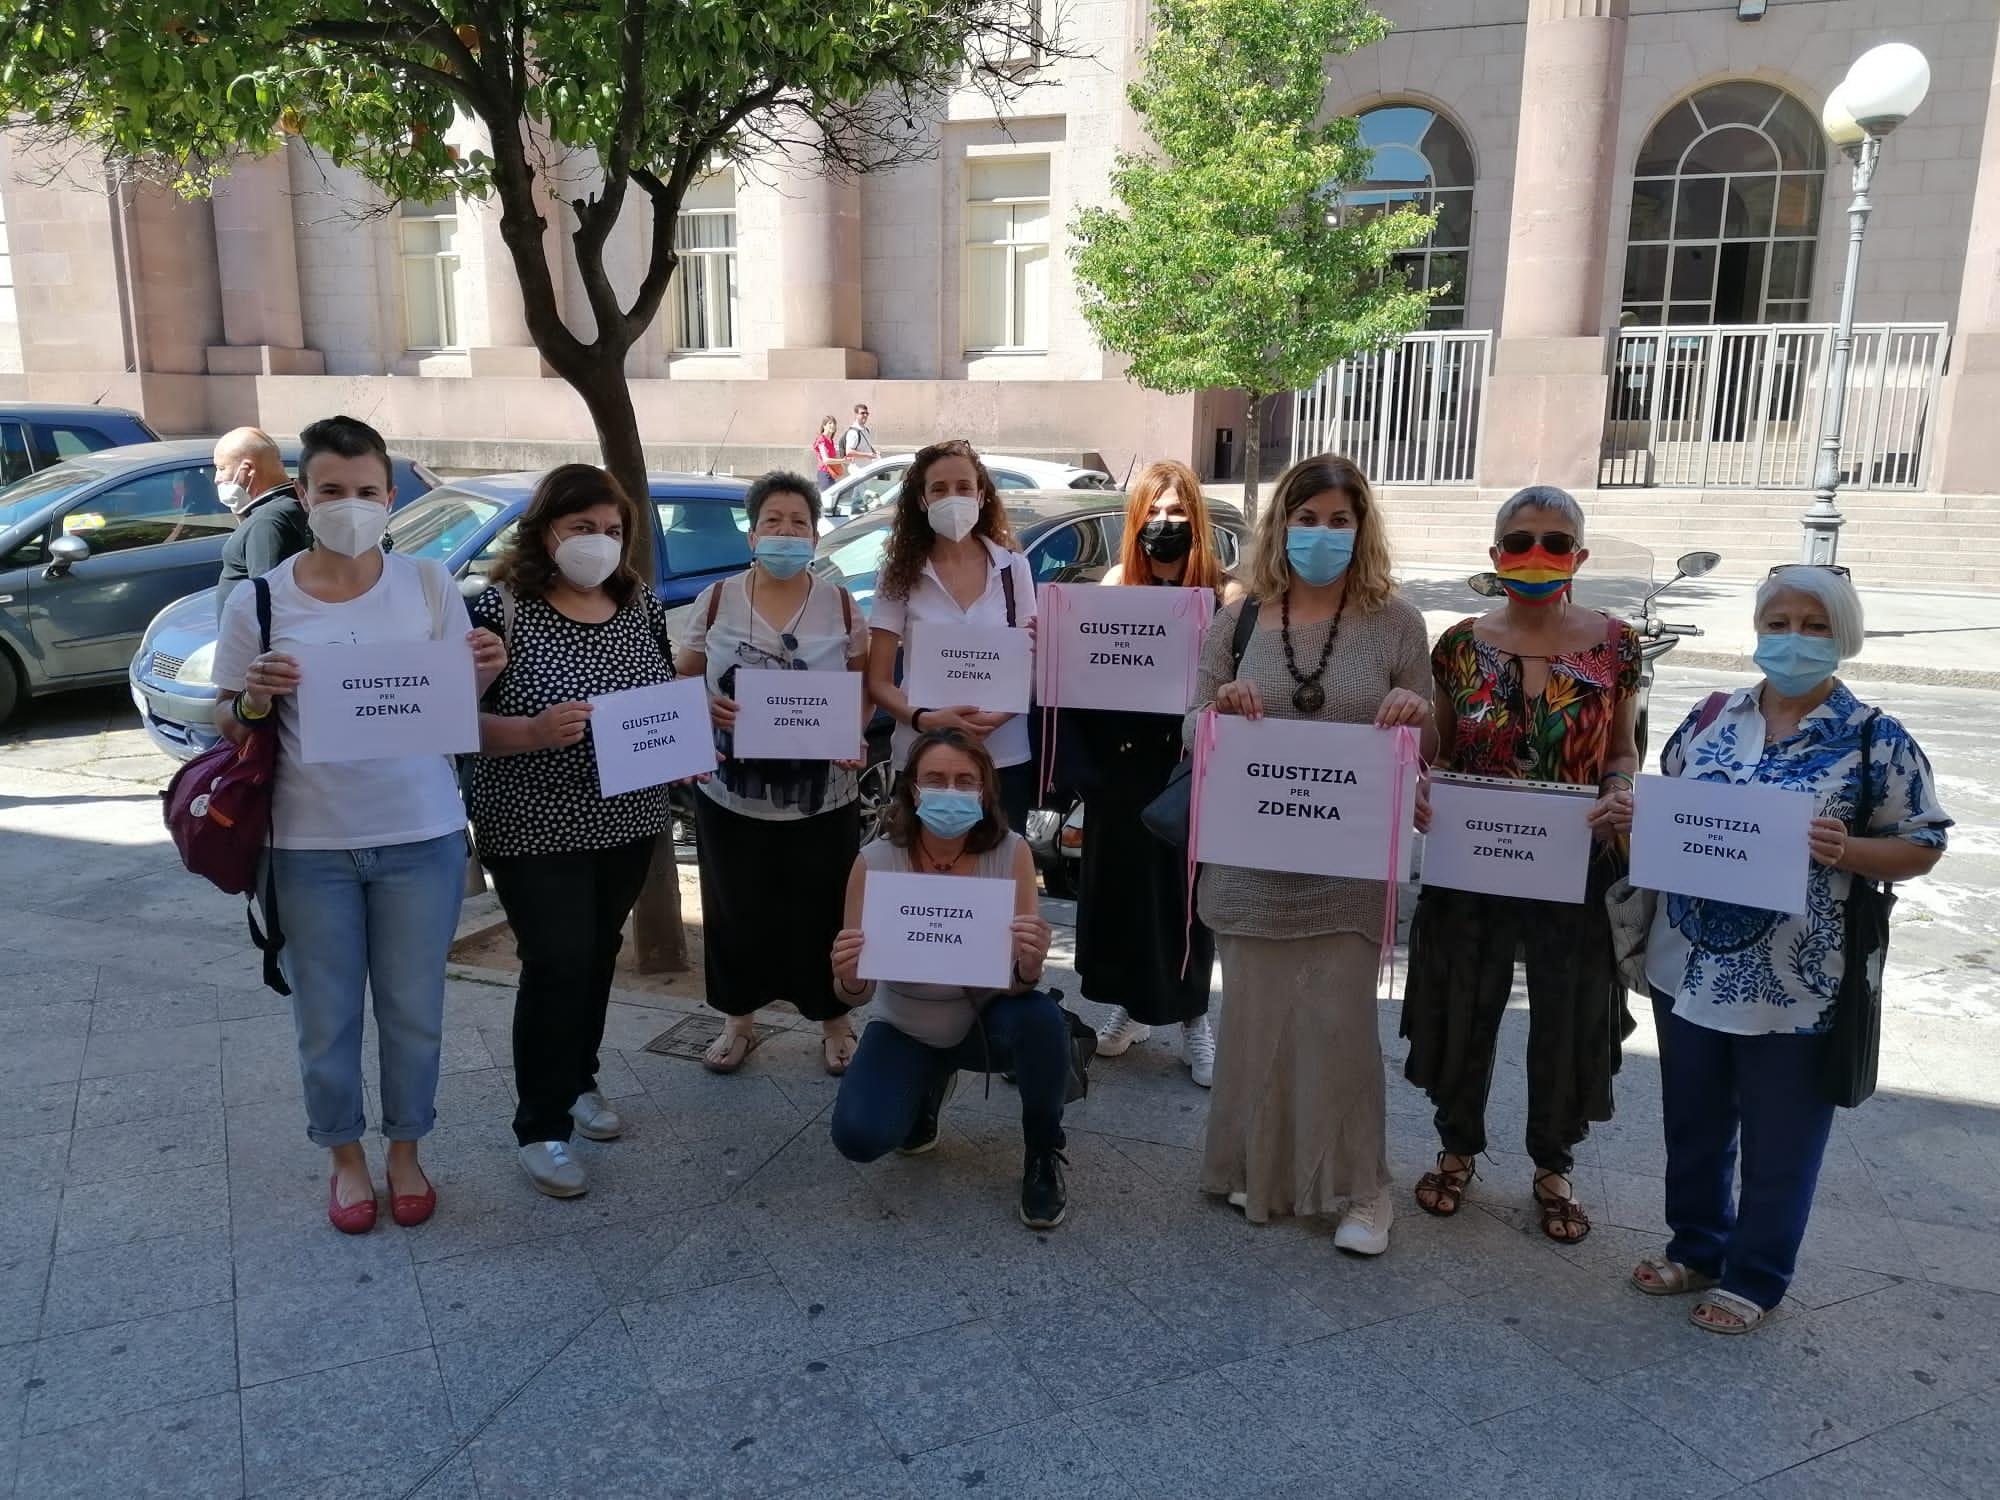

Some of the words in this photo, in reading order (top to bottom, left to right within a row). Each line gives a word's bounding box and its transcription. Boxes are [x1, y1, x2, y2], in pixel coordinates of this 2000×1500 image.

[1080, 623, 1166, 637] GIUSTIZIA
[941, 649, 999, 660] GIUSTIZIA
[1090, 653, 1154, 666] ZDENKA
[947, 670, 991, 680] ZDENKA
[342, 676, 430, 689] GIUSTIZIA
[767, 697, 828, 706] GIUSTIZIA
[355, 704, 422, 716] ZDENKA
[622, 711, 679, 730] GIUSTIZIA
[774, 718, 820, 727] ZDENKA
[632, 735, 676, 752] ZDENKA
[1247, 763, 1357, 784] GIUSTIZIA
[1289, 788, 1311, 798] PER
[1258, 801, 1340, 820] ZDENKA
[1466, 820, 1547, 837] GIUSTIZIA
[1674, 813, 1760, 834] GIUSTIZIA
[1707, 833, 1724, 842] PER
[1473, 846, 1534, 861] ZDENKA
[1683, 842, 1747, 861] ZDENKA
[900, 906, 973, 920] GIUSTIZIA
[907, 931, 962, 944] ZDENKA
